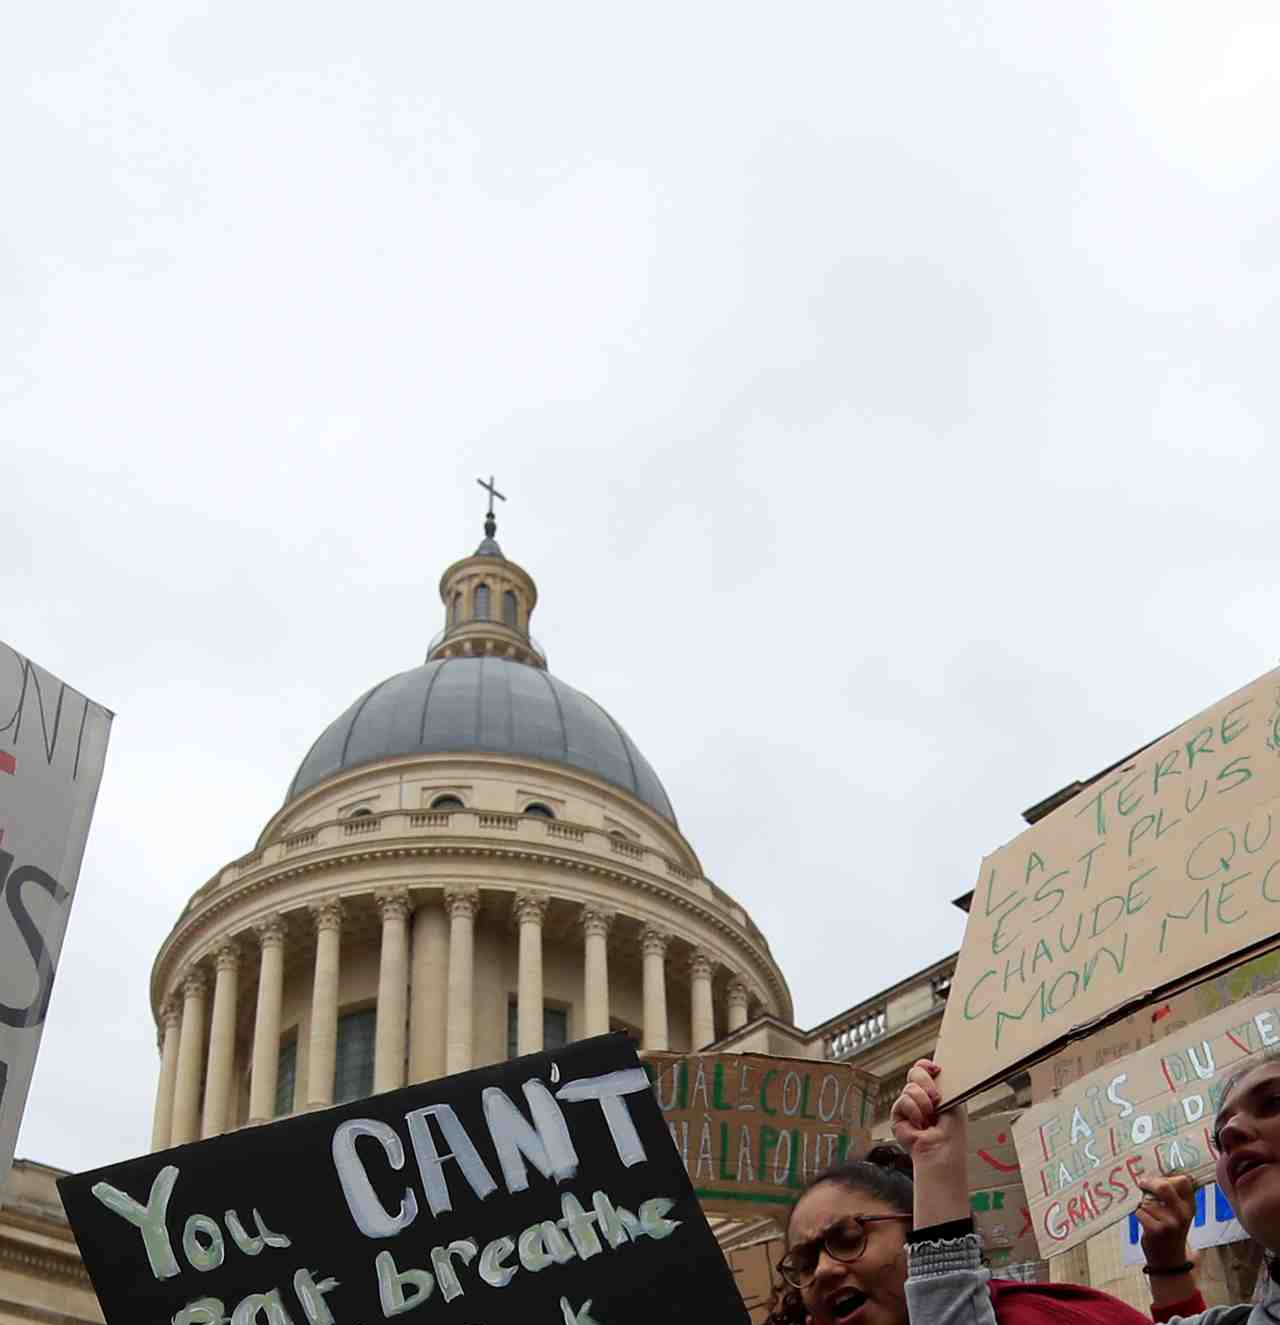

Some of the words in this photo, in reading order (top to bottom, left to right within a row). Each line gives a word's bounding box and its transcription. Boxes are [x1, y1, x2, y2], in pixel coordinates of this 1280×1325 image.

[984, 850, 1046, 917] LA
[1074, 698, 1254, 835] TERRE
[991, 842, 1107, 955] EST
[1127, 755, 1253, 857] PLUS
[963, 865, 1158, 1020] CHAUDE
[995, 932, 1128, 1050] MON
[91, 1164, 293, 1281] You
[331, 1061, 652, 1240] CAN'T
[376, 1190, 684, 1318] breathe
